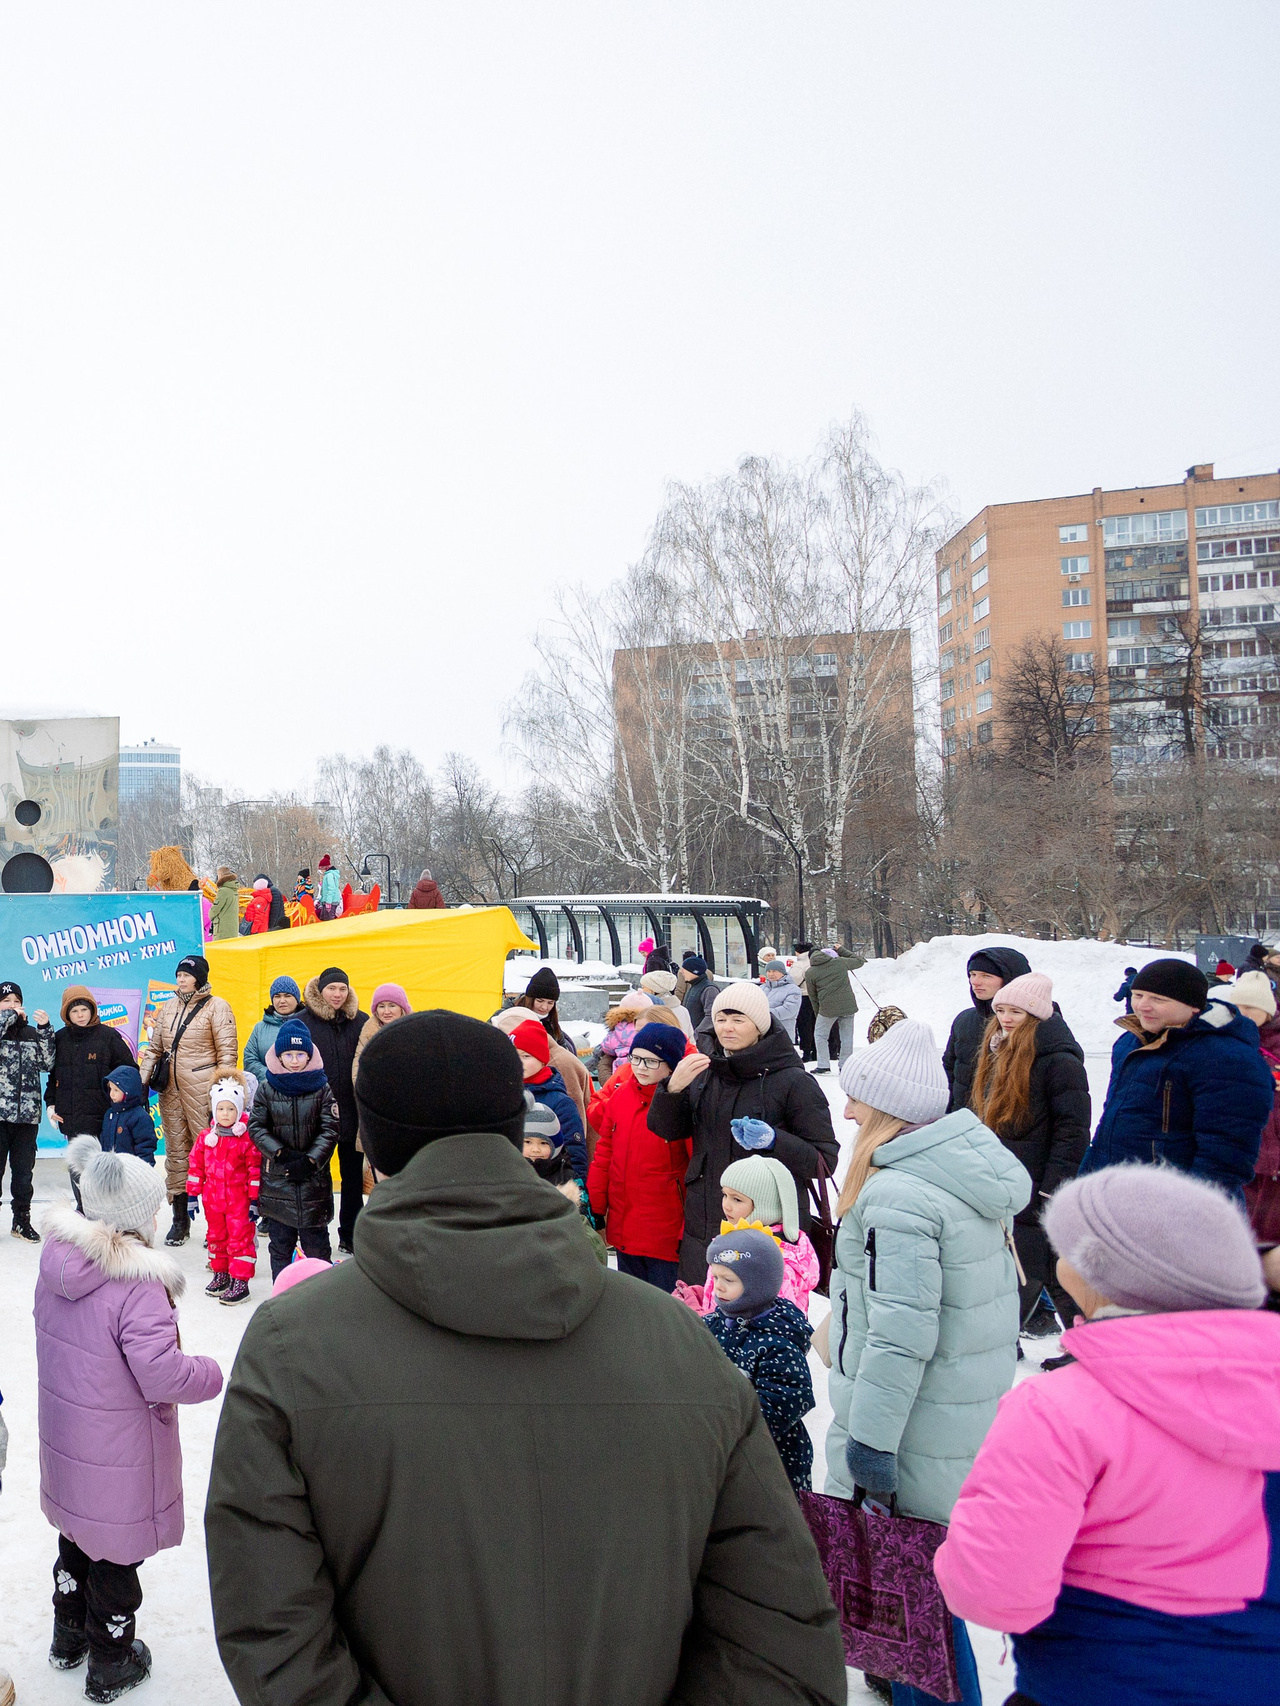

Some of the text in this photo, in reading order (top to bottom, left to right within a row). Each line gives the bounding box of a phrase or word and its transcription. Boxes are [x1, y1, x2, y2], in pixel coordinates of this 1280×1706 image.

[21, 910, 158, 966] ОМНОМНОМ
[41, 968, 52, 982] И
[53, 959, 89, 980] ХРУМ
[96, 949, 131, 970] ХРУМ
[139, 939, 177, 960] ХРУМ!
